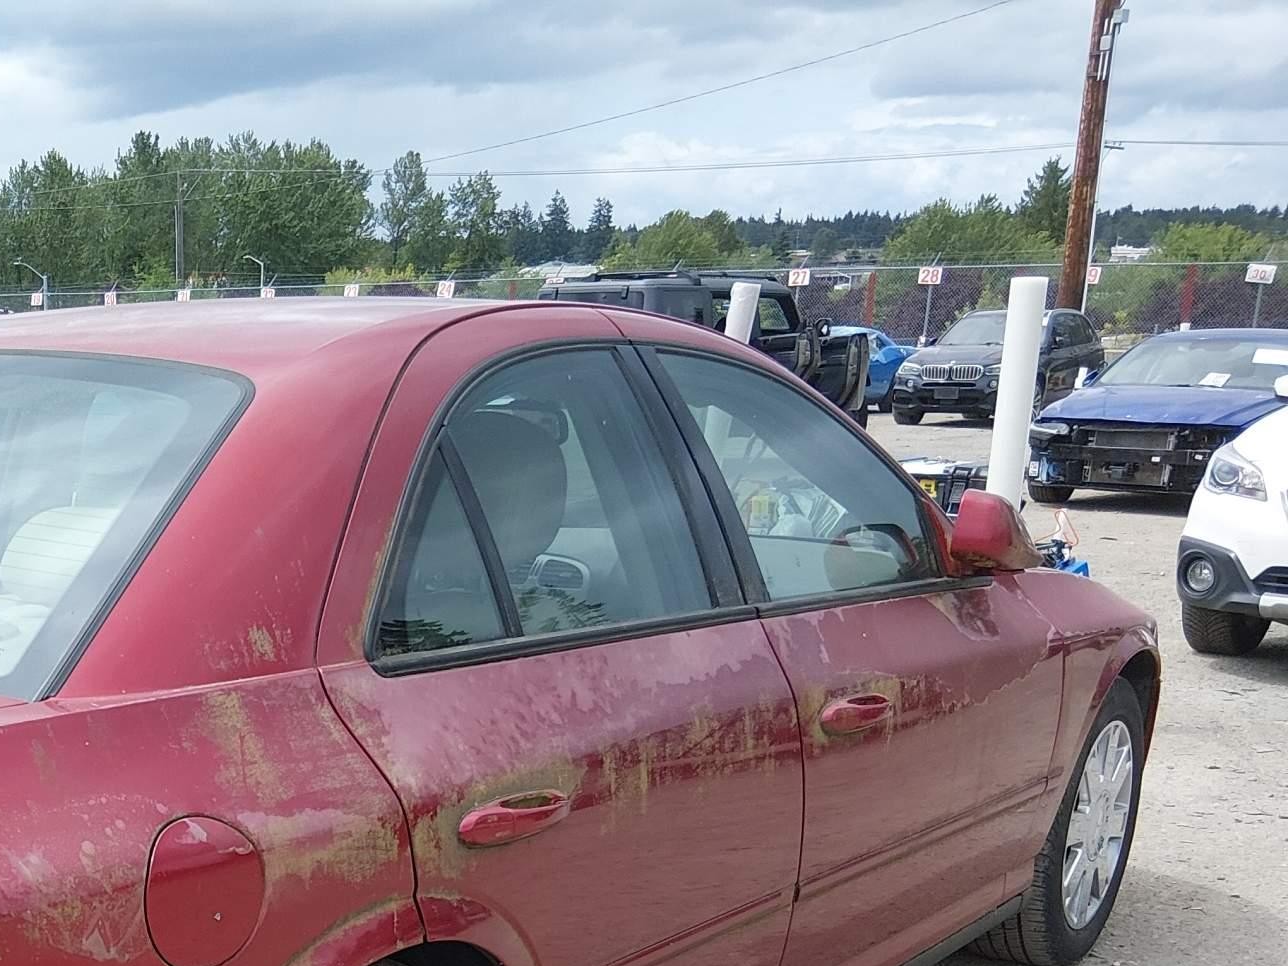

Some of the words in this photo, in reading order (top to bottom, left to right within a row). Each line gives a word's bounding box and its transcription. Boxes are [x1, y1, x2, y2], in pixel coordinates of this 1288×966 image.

[792, 270, 807, 285] 27
[920, 269, 940, 284] 28
[438, 282, 454, 297] 24
